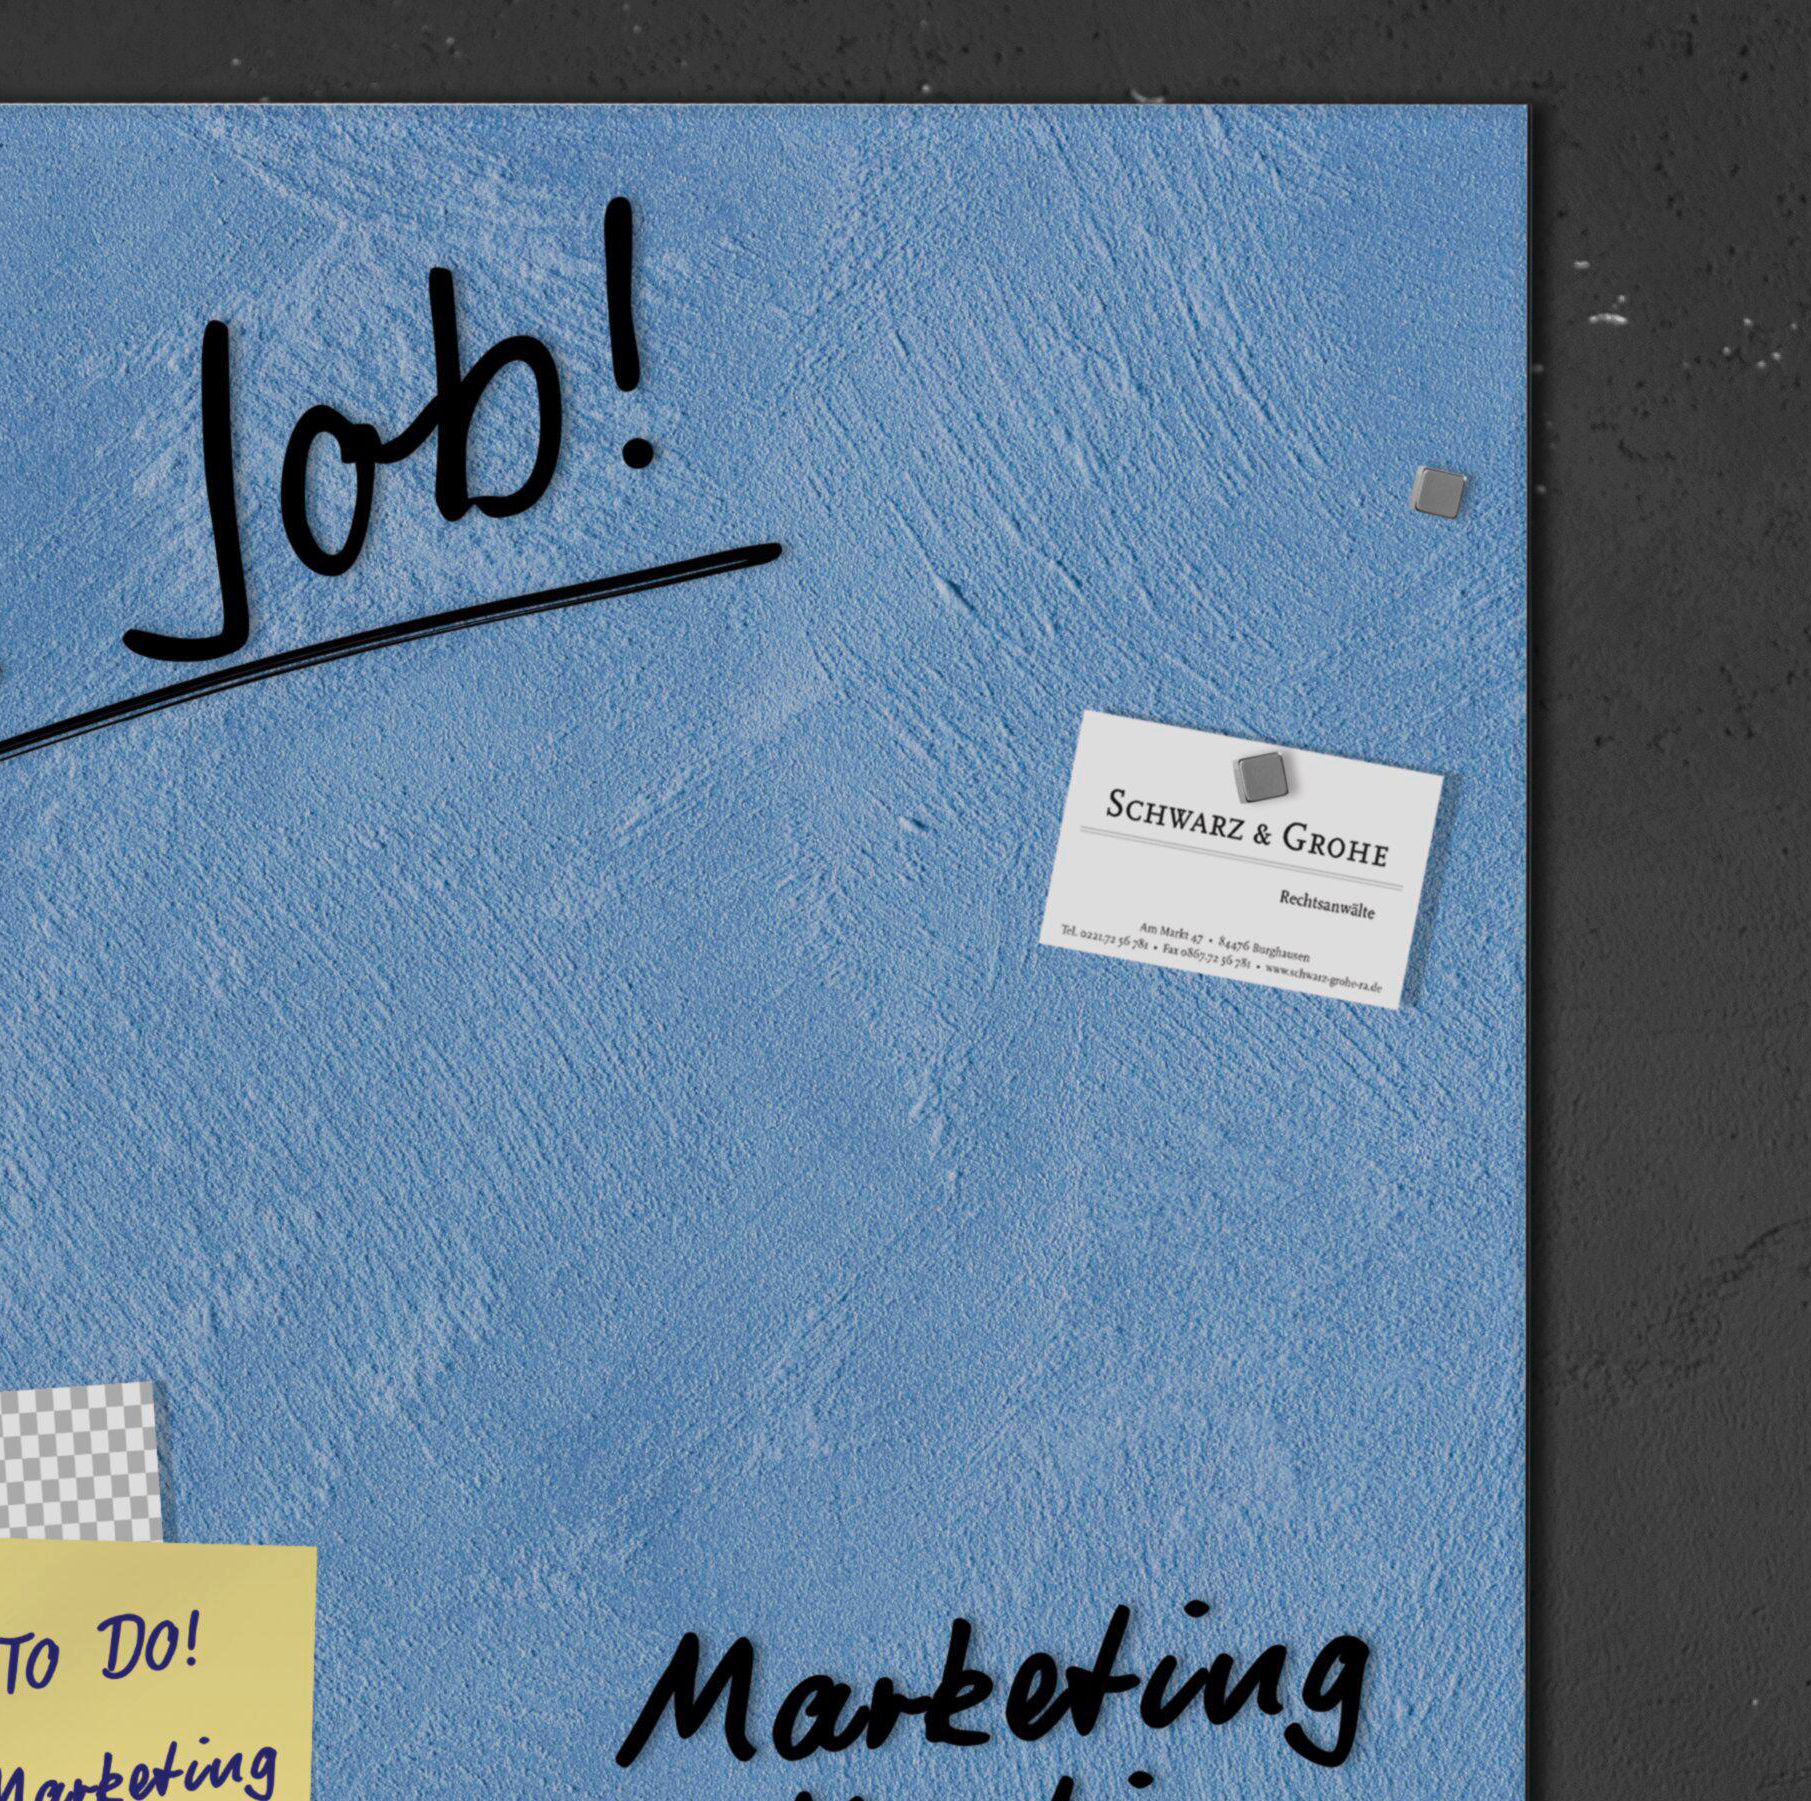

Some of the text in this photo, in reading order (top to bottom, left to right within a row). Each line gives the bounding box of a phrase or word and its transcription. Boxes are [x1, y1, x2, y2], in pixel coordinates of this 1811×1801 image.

[121, 196, 656, 664] Job!
[1279, 889, 1376, 920] Rechtsanwälte
[615, 1599, 1372, 1769] Marketing
